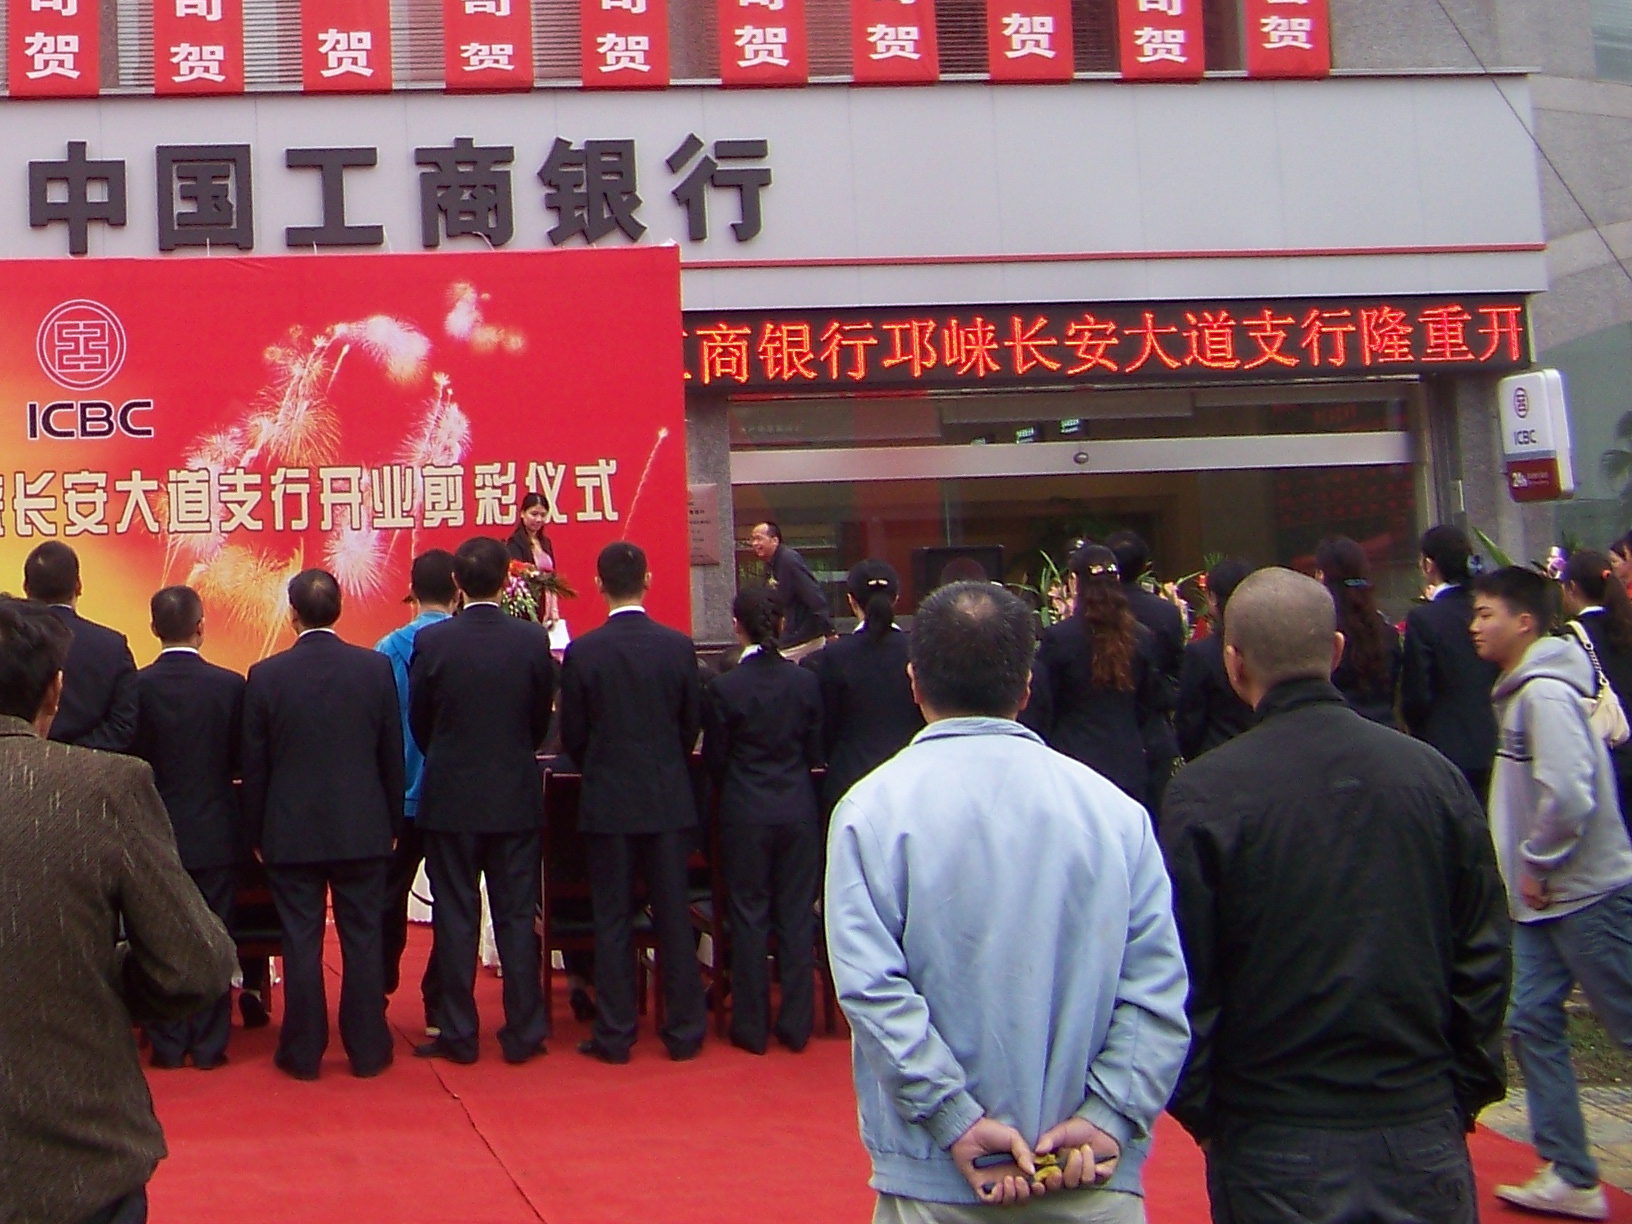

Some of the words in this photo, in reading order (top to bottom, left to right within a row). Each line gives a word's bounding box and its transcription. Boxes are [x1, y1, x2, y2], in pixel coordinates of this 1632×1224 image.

[27, 132, 774, 256] 中国工商银行
[683, 303, 1524, 386] 商银行邛崃长安大道支行隆重开
[26, 398, 155, 441] ICBC
[1513, 429, 1537, 445] ICBC
